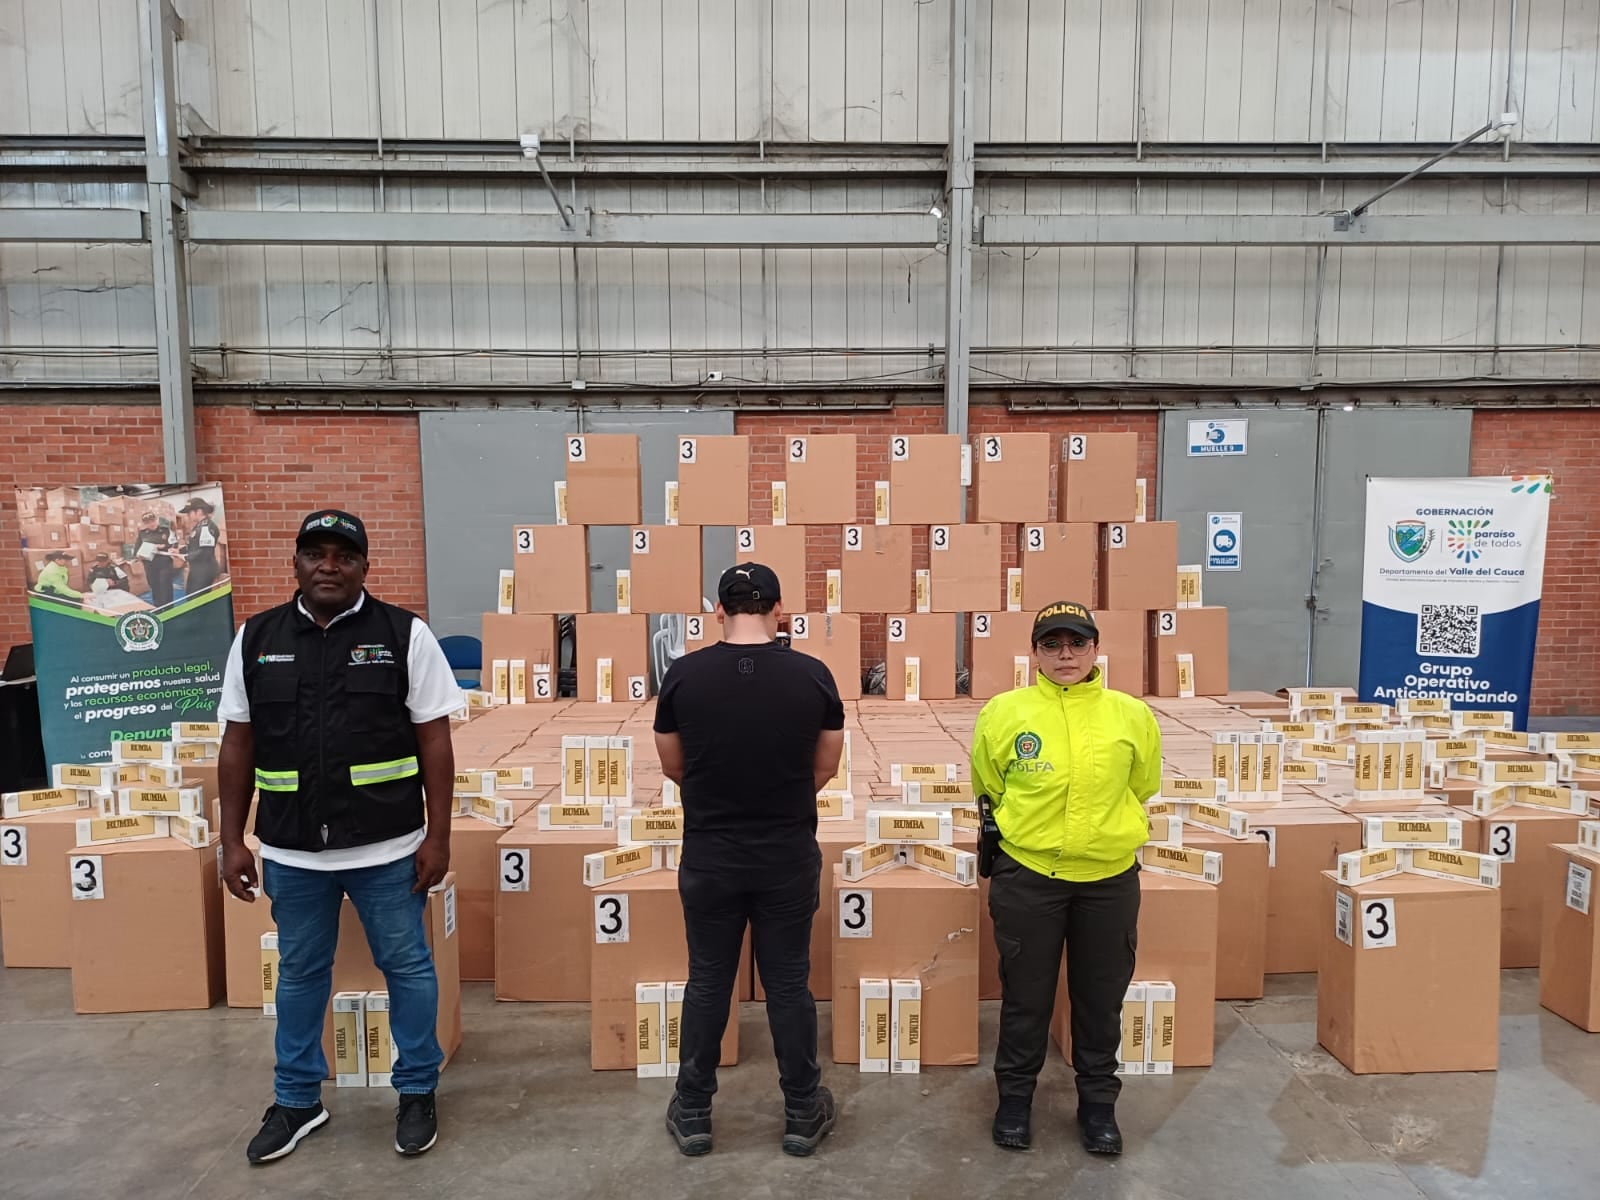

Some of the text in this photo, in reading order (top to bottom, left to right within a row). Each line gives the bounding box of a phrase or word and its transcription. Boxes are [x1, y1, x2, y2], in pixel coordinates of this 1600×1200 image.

[570, 438, 582, 457] 3
[682, 440, 693, 458] 3
[792, 440, 803, 458] 3
[894, 438, 906, 456] 3
[987, 438, 998, 457] 3
[1072, 437, 1083, 454] 3
[1416, 506, 1494, 516] GOBERNACIÓN
[519, 531, 530, 548] 3
[635, 532, 646, 549] 3
[740, 530, 751, 548] 3
[848, 528, 858, 546] 3
[934, 528, 946, 546] 3
[1030, 529, 1041, 546] 3
[1112, 526, 1123, 544] 3
[1474, 538, 1522, 548] de todos
[1475, 530, 1514, 539] paraíso
[1380, 568, 1433, 576] Departamento
[1450, 568, 1474, 576] Valle
[1494, 568, 1524, 576] Cauca
[1038, 604, 1088, 622] POLICIA
[1162, 613, 1173, 630] 3
[690, 618, 700, 635] 3
[794, 617, 805, 634] 3
[891, 620, 902, 638] 3
[976, 615, 988, 632] 3
[81, 673, 118, 682] consumir
[132, 666, 181, 679] producto
[1420, 662, 1472, 678] Grupo
[66, 678, 160, 699] protegemos
[194, 672, 220, 682] salud
[1404, 675, 1490, 690] Operativo
[85, 693, 134, 706] recursos
[137, 686, 204, 700] económicos
[1374, 686, 1518, 702] Anticontrabando
[85, 703, 156, 722] progreso
[174, 695, 216, 716] País
[894, 820, 924, 829] RUMBA
[1398, 822, 1432, 832] RUMBA
[4, 829, 22, 858] 3
[1493, 826, 1511, 856] 3
[616, 851, 640, 865] RUMBA
[1157, 850, 1188, 862] RUMBA
[1428, 851, 1464, 866] RUMBA
[75, 860, 97, 892] 3
[504, 852, 524, 884] 3
[600, 898, 622, 934] 3
[844, 894, 866, 929] 3
[1366, 902, 1389, 939] 3
[264, 962, 272, 990] RUMBA
[640, 1018, 649, 1050] RUMBA
[668, 1016, 678, 1048] RUMBA
[877, 1014, 886, 1044] RUMBA
[910, 1014, 919, 1046] RUMBA
[1133, 1016, 1142, 1047] RUMBA
[1162, 1016, 1172, 1047] RUMBA
[337, 1028, 346, 1060] RUMBA
[370, 1026, 379, 1058] RUMBA
